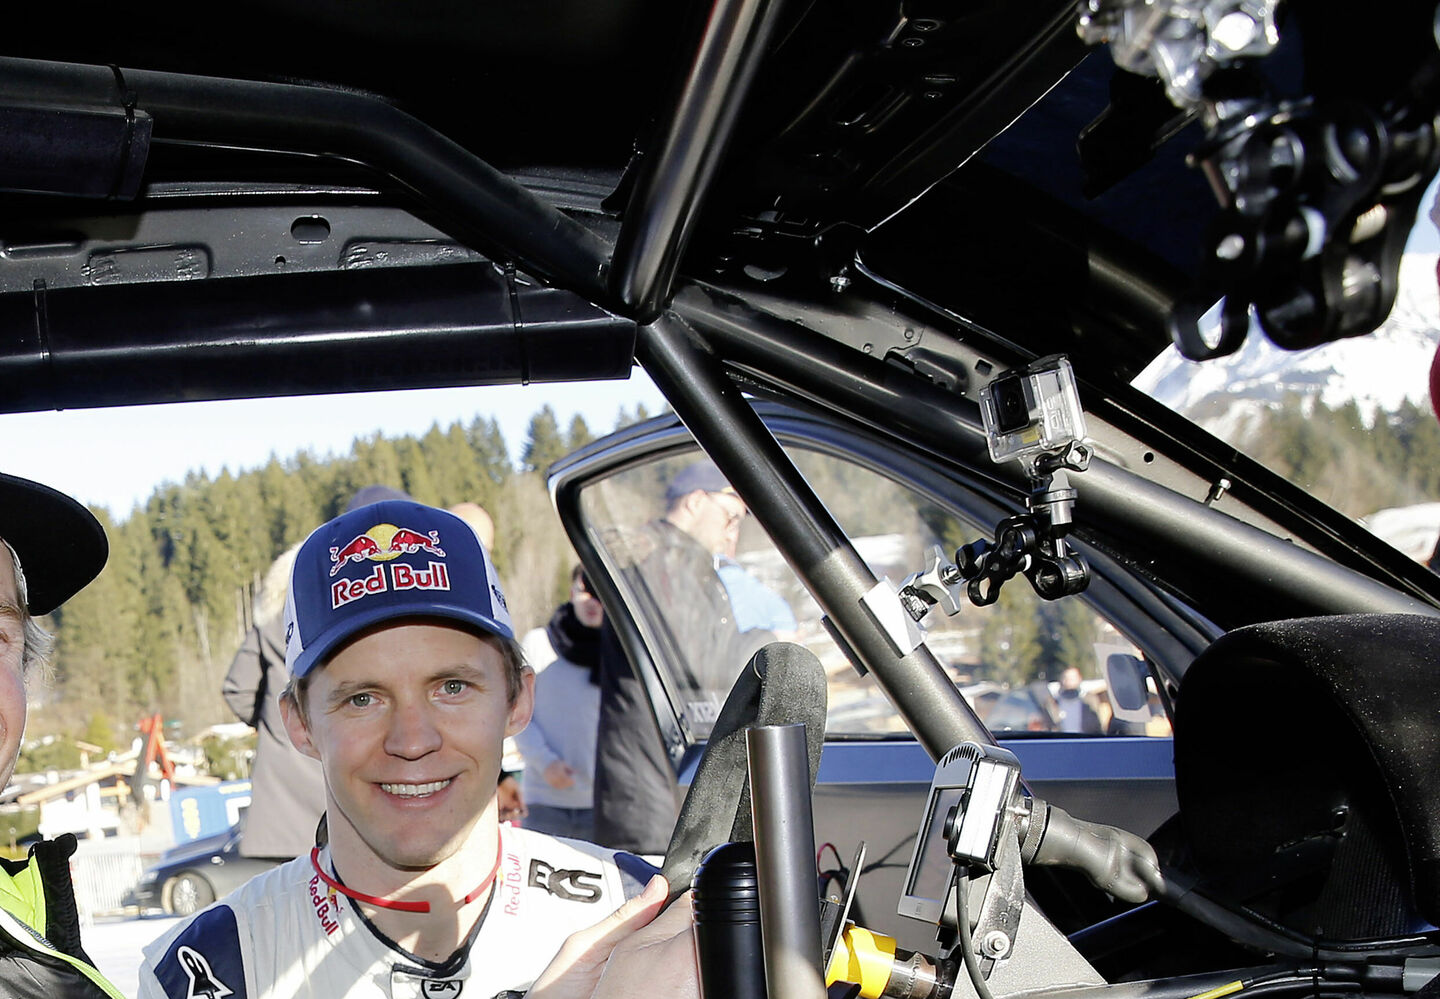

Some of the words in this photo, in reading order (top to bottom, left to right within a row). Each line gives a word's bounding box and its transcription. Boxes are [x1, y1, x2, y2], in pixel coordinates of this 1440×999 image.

[331, 564, 387, 608] Red
[391, 562, 450, 591] Bull
[507, 853, 522, 882] Bull
[528, 858, 602, 903] EKS
[309, 874, 327, 907] Red
[504, 884, 521, 916] Red
[317, 903, 339, 936] Bull
